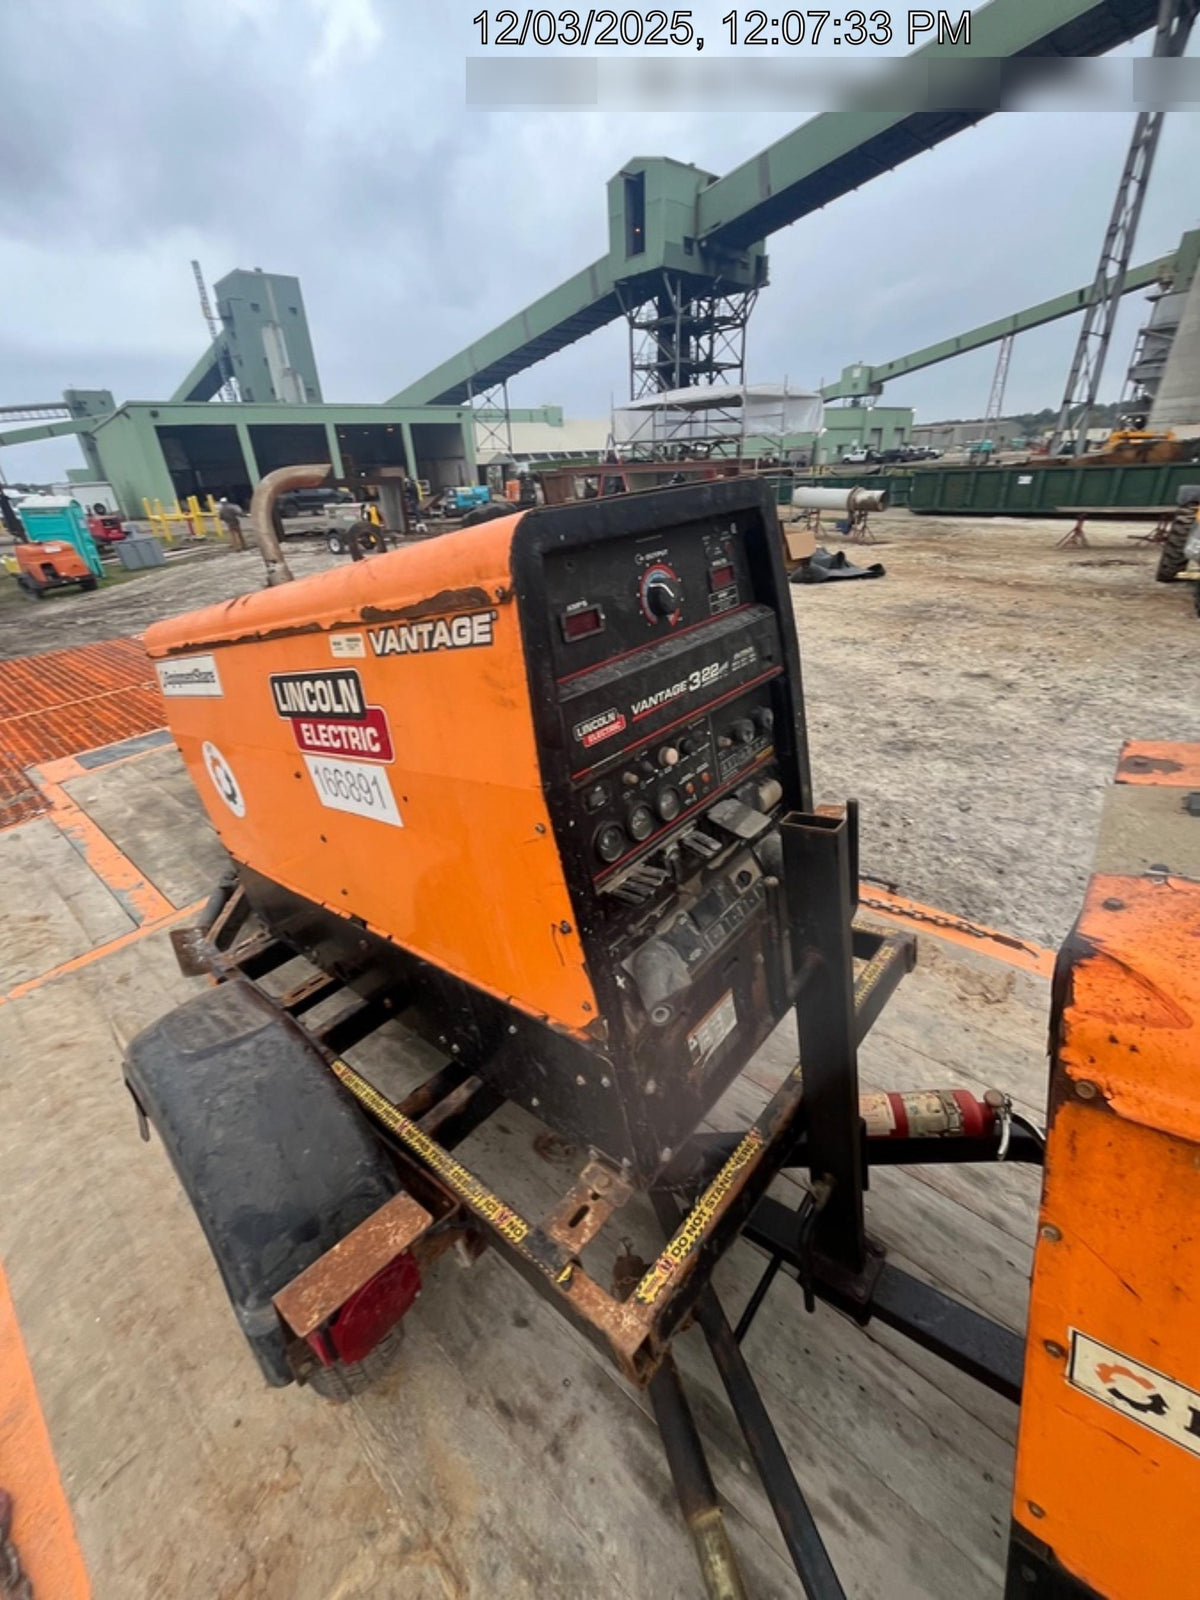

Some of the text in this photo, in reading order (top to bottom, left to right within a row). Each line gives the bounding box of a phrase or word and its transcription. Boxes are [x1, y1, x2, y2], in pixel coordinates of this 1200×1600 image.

[368, 612, 492, 656] VANTAGE
[274, 678, 361, 714] LINCOLN
[631, 680, 688, 715] VANTAGE
[300, 723, 381, 752] ELECTRIC
[576, 711, 616, 737] LINCOLN
[314, 764, 386, 809] 166891
[671, 1236, 689, 1258] DO
[686, 1209, 707, 1236] NOT
[704, 1169, 734, 1208] STAND
